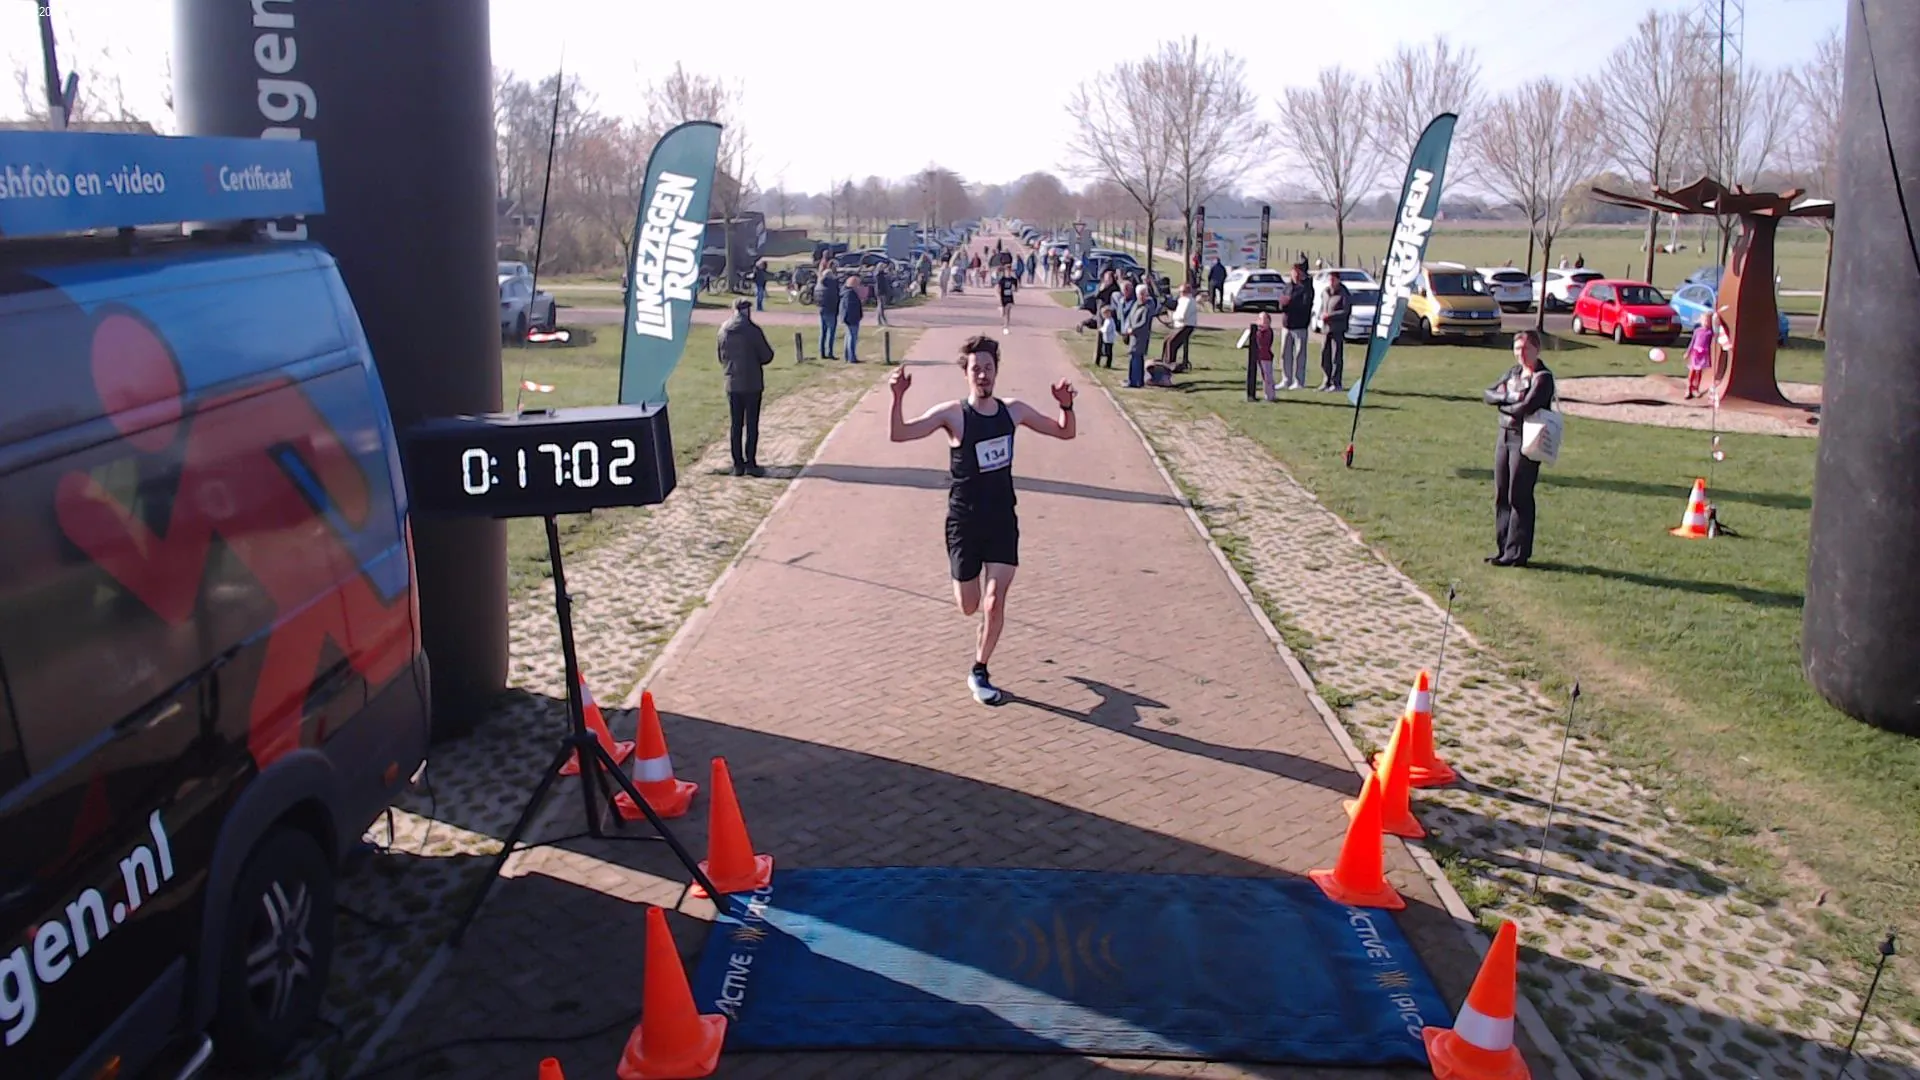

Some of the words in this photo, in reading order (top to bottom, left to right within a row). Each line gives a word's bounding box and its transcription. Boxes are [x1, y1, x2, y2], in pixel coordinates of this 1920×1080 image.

[75, 173, 101, 196] en
[105, 165, 165, 194] -video
[219, 164, 293, 192] Certificaat
[635, 171, 698, 341] LINGEZEGEN
[662, 218, 705, 301] RUN
[462, 438, 636, 495] 0:17:02
[985, 448, 1006, 461] 134
[0, 808, 174, 1047] gen.nl
[714, 952, 753, 1022] ACTIVE
